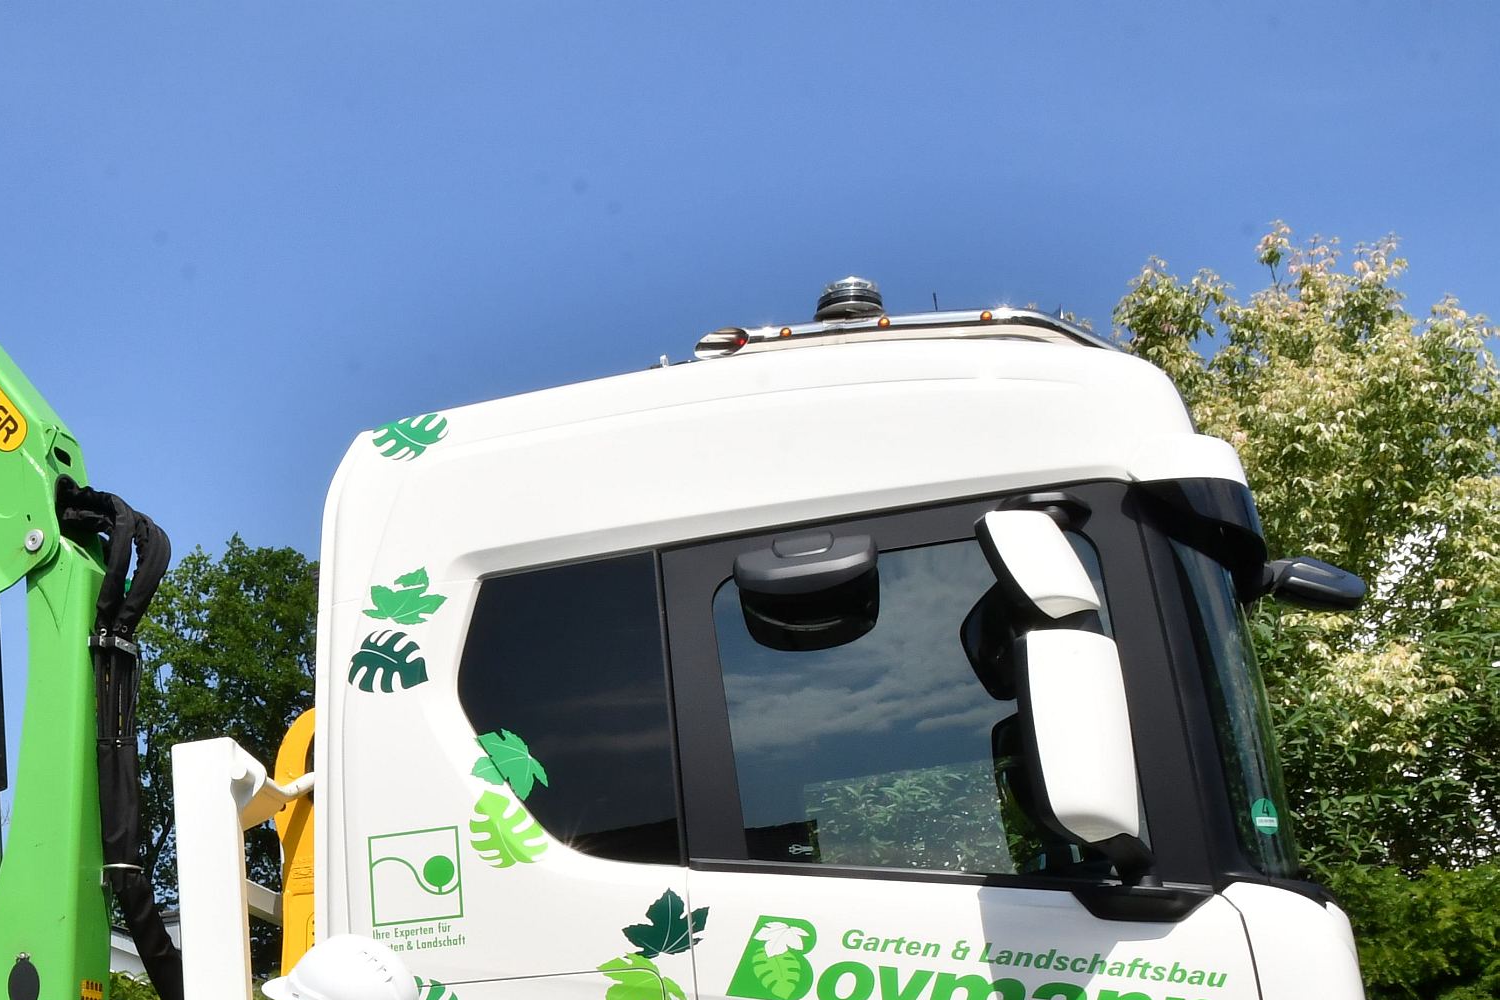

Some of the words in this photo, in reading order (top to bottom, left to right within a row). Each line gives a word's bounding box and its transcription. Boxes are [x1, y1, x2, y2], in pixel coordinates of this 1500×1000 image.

[372, 929, 391, 941] Ihre
[394, 926, 434, 940] Experten
[438, 922, 452, 934] für
[388, 941, 405, 952] ten
[406, 940, 414, 950] &
[416, 934, 466, 949] Landschaft
[841, 928, 942, 958] Garten
[951, 934, 970, 960] &
[979, 941, 1228, 989] Landschaftsbau
